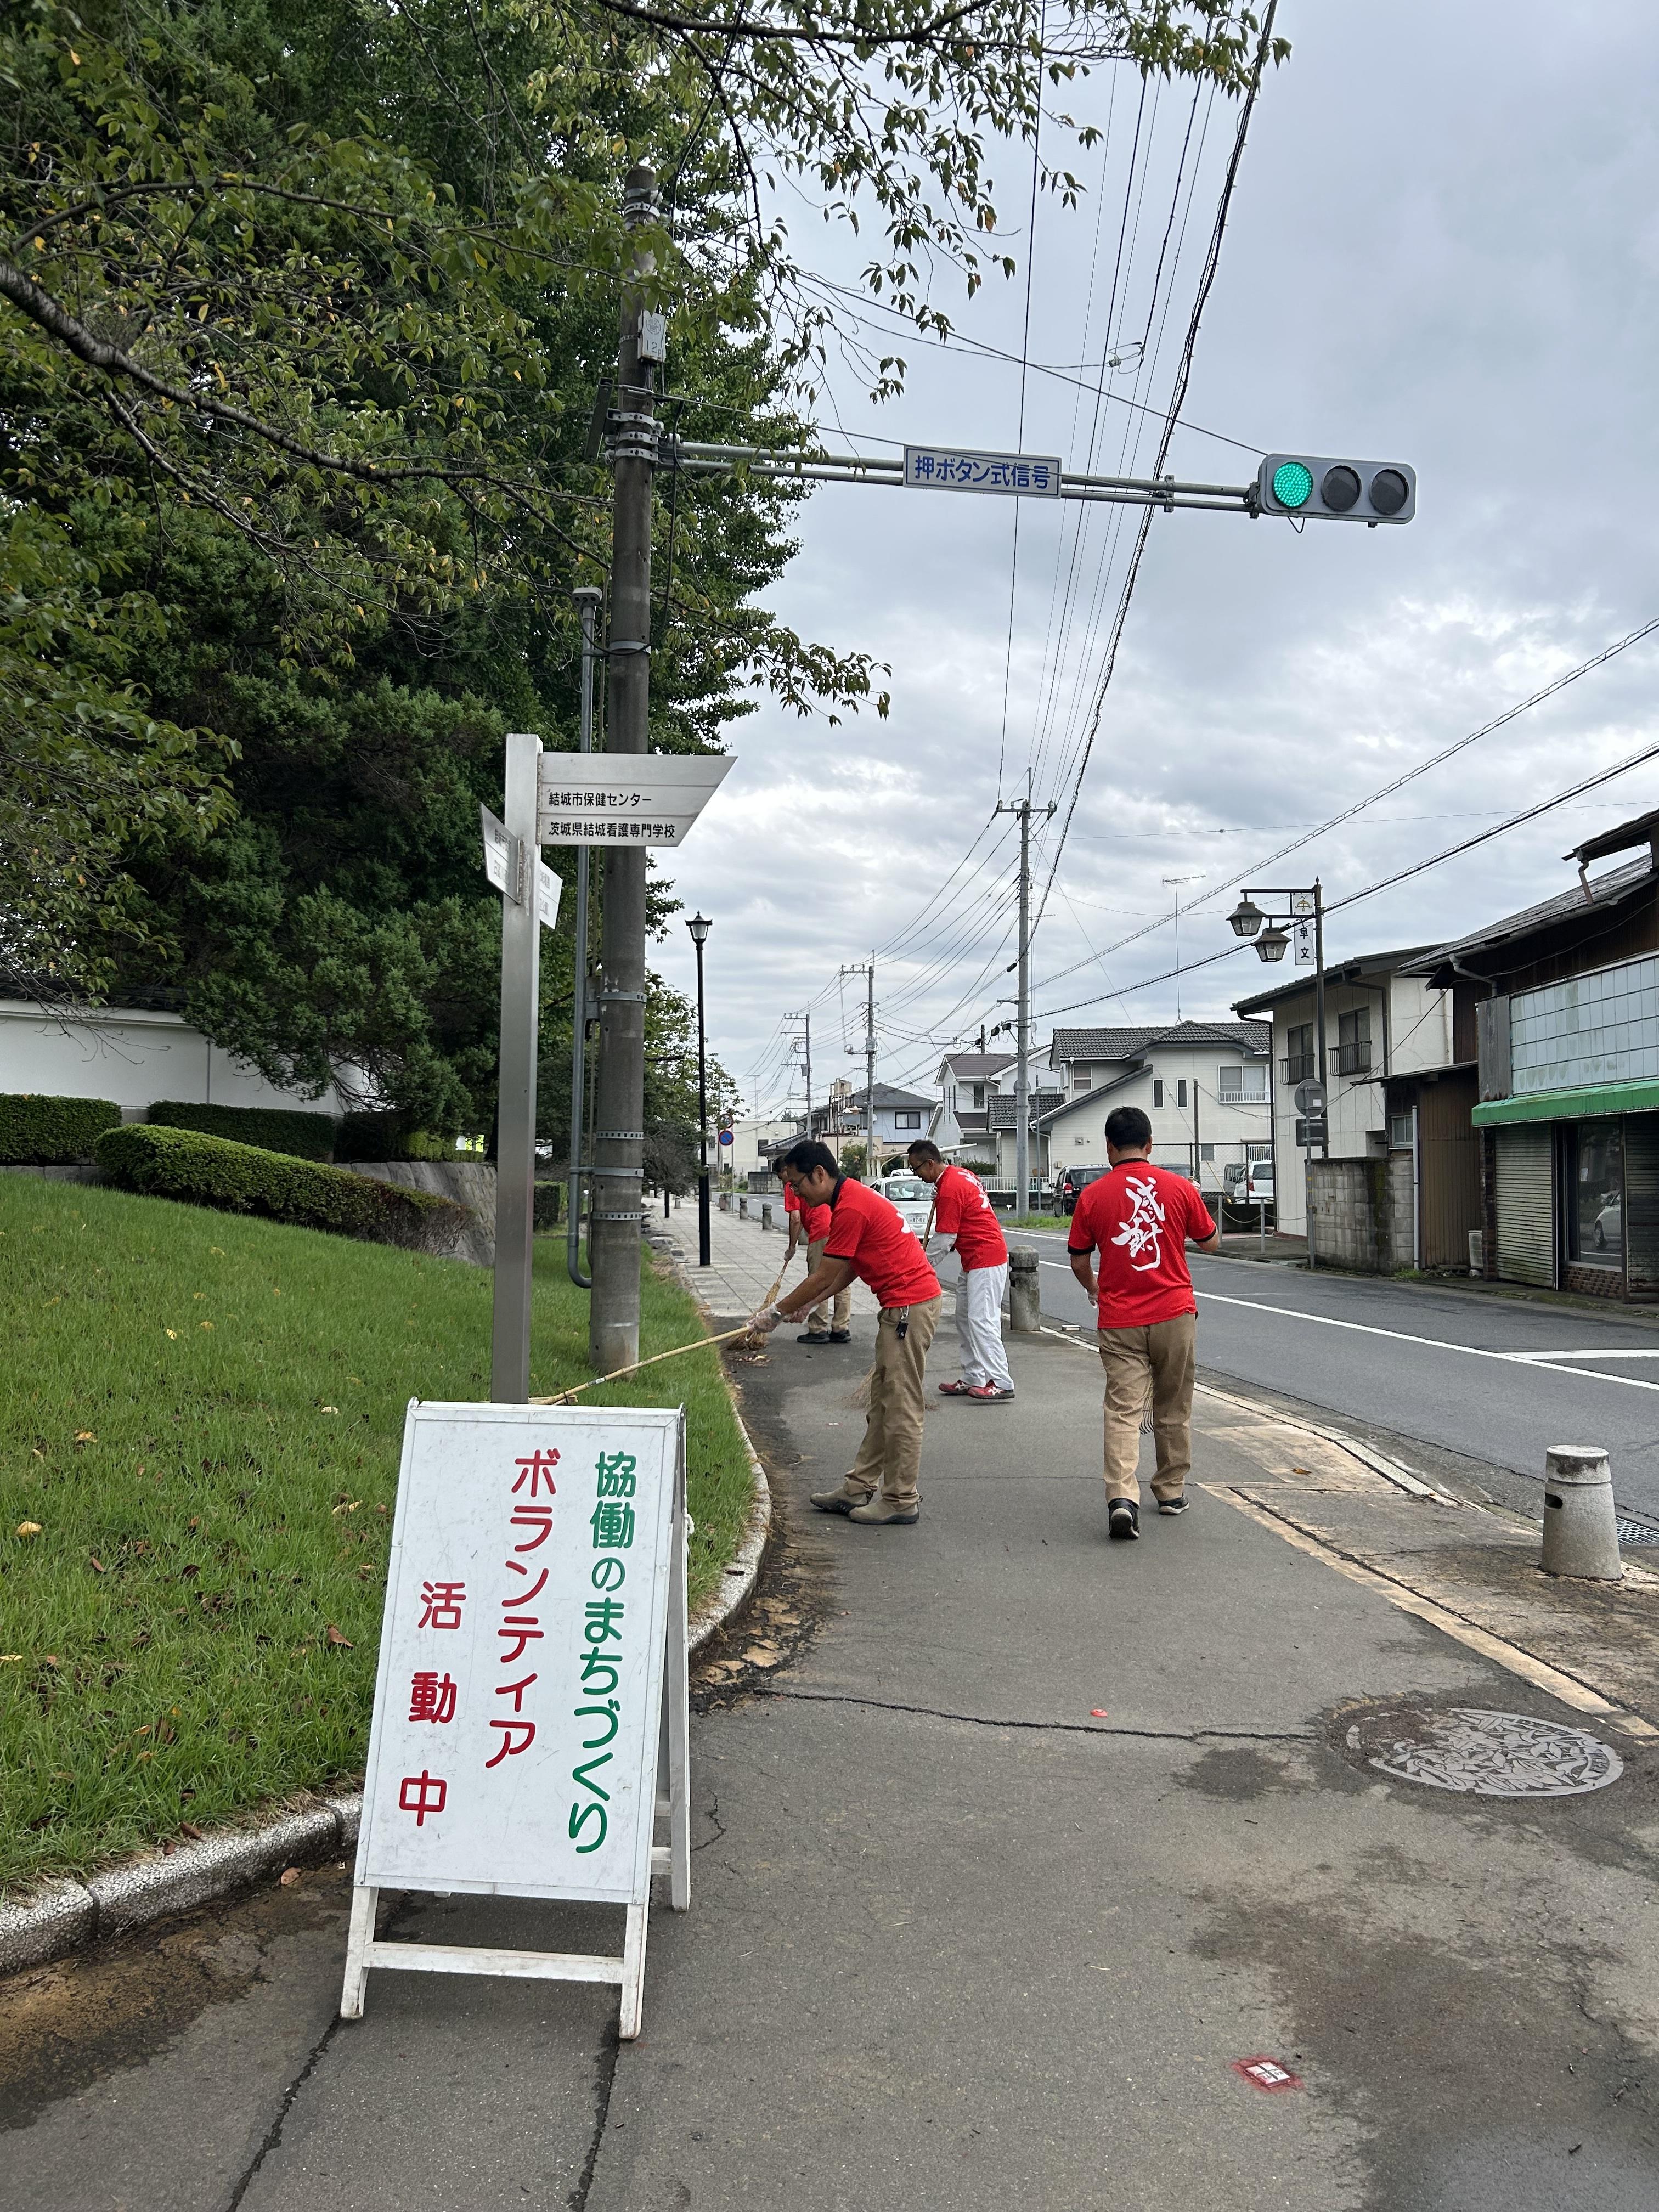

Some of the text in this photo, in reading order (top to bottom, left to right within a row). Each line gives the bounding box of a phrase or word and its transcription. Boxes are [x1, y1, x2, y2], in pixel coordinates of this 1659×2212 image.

[915, 455, 1051, 489] 押ボタン式信号
[549, 792, 652, 807] 結城市保健センター
[549, 821, 675, 838] 茨城県結城看護専門学校
[1111, 1176, 1166, 1272] 感謝
[486, 1448, 561, 1768] ボランティア
[569, 1451, 637, 1853] 協働のまちづくり
[399, 1581, 466, 1827] 活動中
